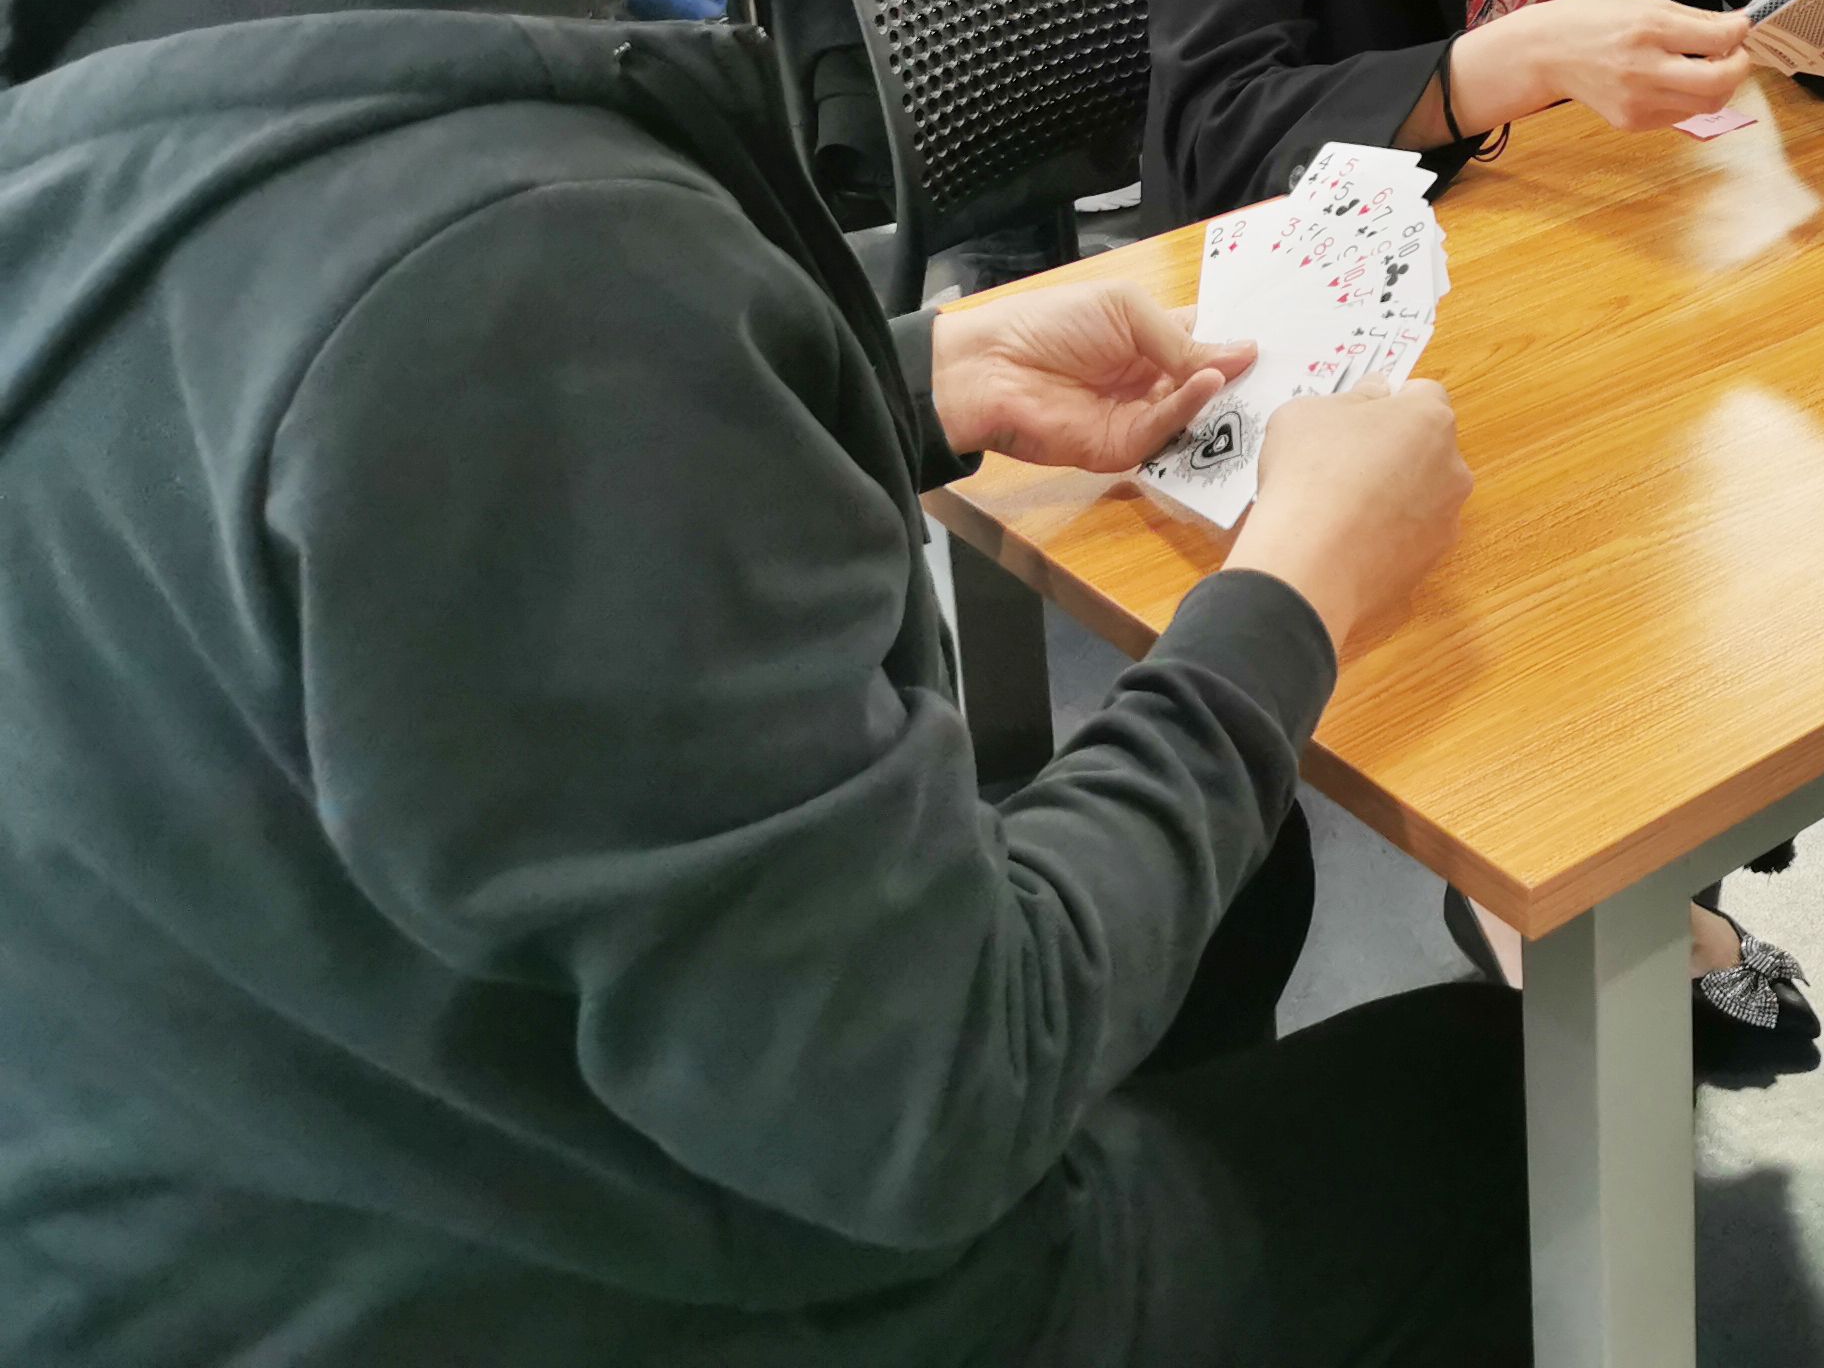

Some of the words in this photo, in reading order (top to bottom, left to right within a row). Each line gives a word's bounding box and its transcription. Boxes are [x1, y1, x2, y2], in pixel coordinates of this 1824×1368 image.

[1319, 152, 1335, 169] 4
[1339, 158, 1359, 177] 5
[1334, 181, 1355, 201] 5
[1373, 187, 1393, 205] 6
[1231, 220, 1246, 238] 2
[1281, 217, 1301, 237] 3
[1402, 221, 1425, 238] 8
[1211, 228, 1223, 245] 2
[1314, 237, 1334, 255] 8
